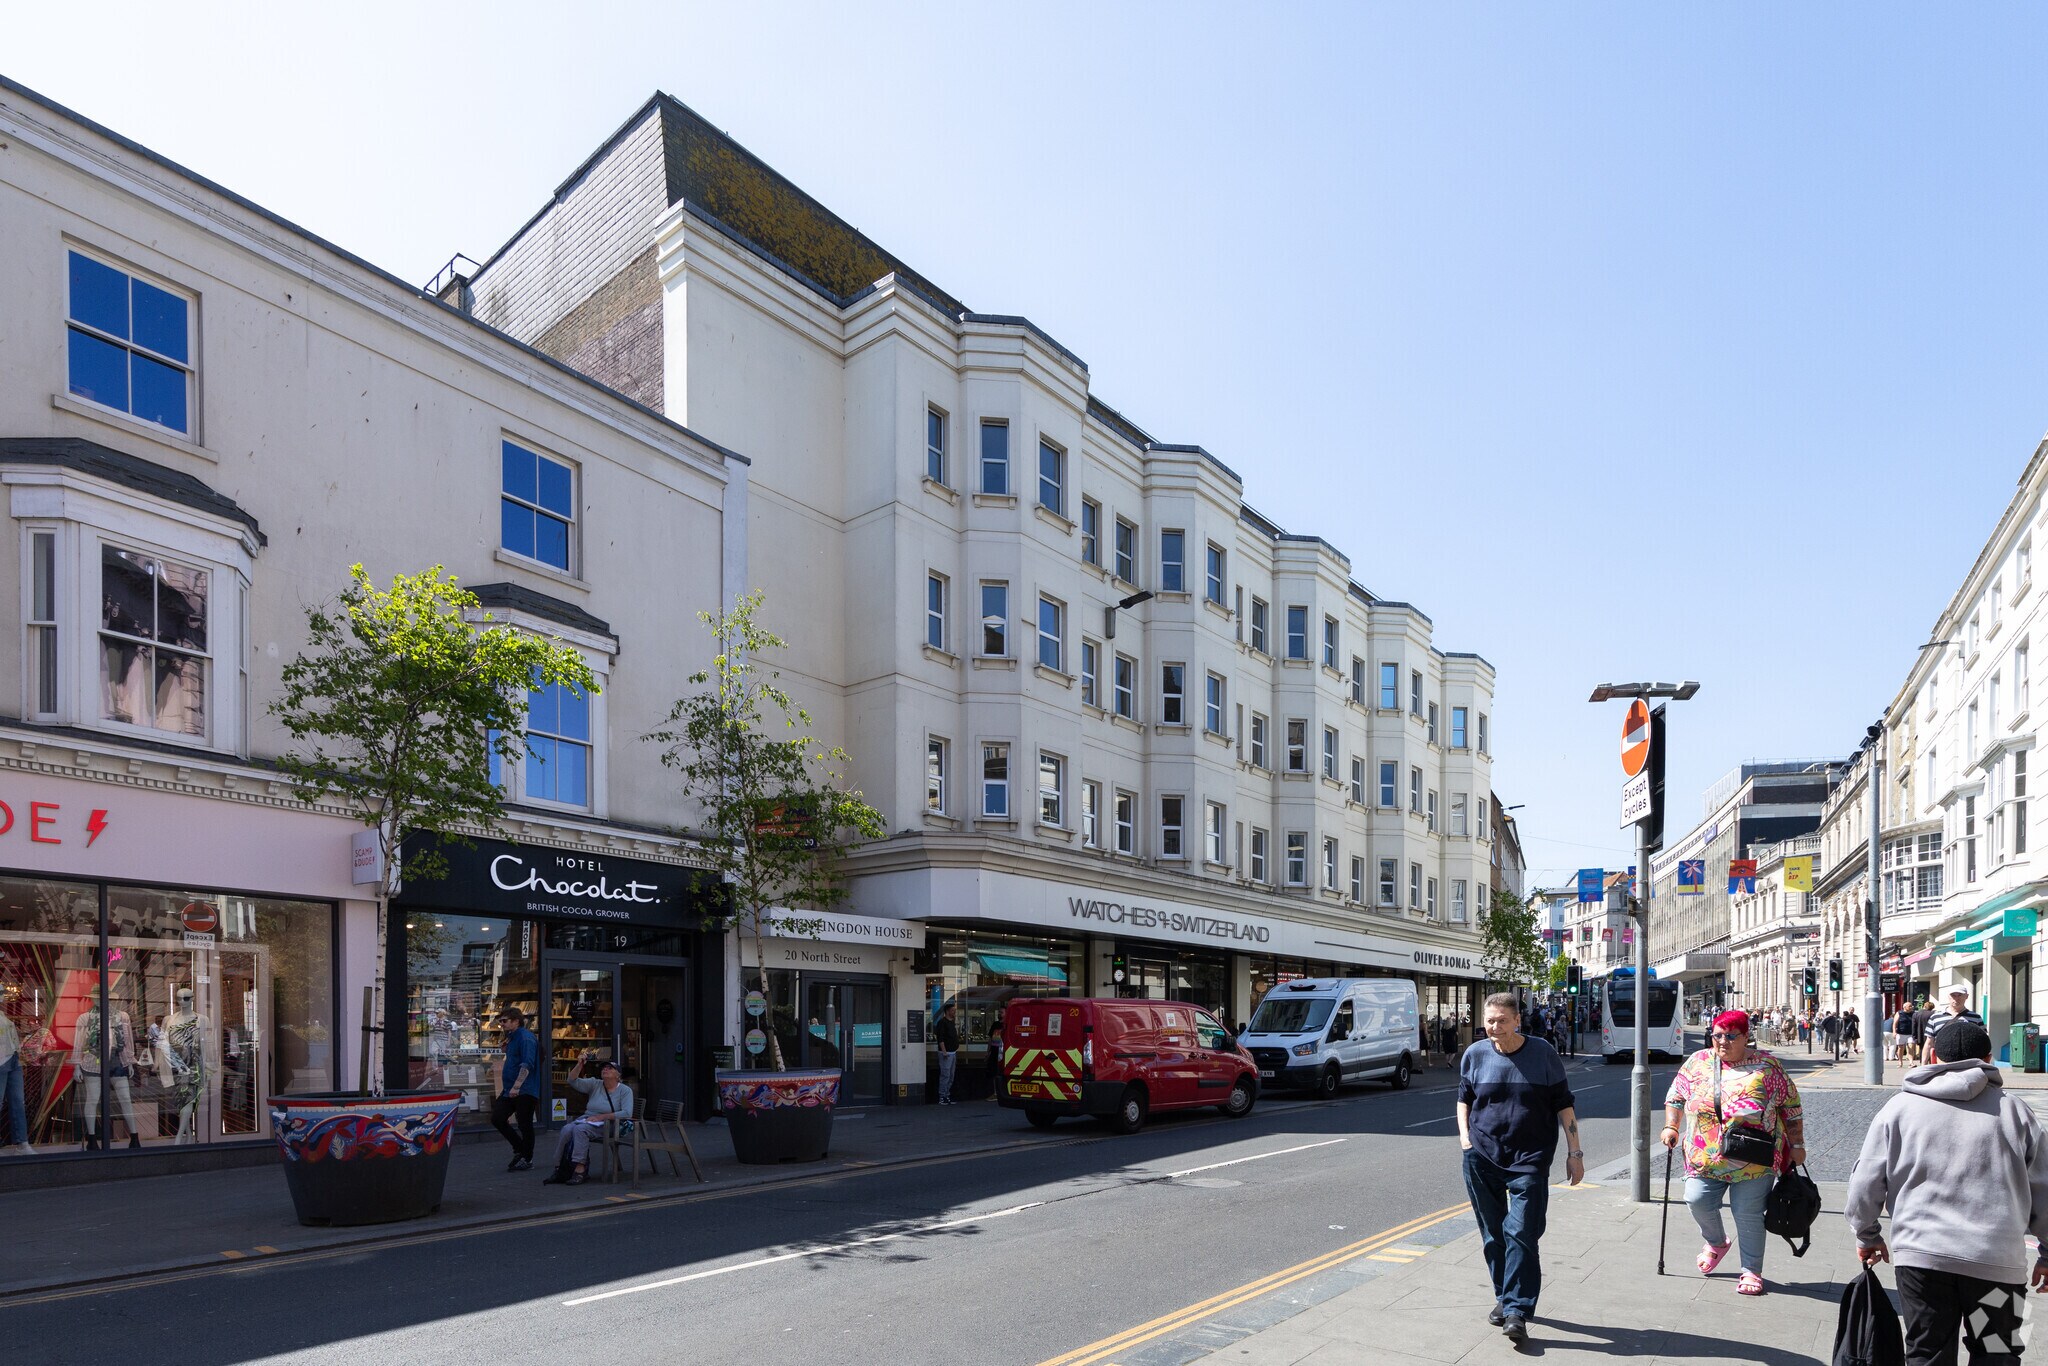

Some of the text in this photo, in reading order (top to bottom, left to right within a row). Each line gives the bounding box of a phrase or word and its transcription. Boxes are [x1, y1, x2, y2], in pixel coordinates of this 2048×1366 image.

[1624, 778, 1647, 802] Except
[1624, 798, 1647, 818] cycles
[355, 847, 373, 858] SCAMP
[556, 856, 605, 873] HOTEL
[527, 902, 630, 919] BRITISH COCOA GROWER
[1068, 896, 1157, 928] WATCHES
[1170, 913, 1270, 943] SWITZERLAND
[614, 935, 628, 947] 19
[875, 926, 913, 940] HOUSE
[784, 949, 861, 965] 20 North Street
[1413, 951, 1471, 970] OLIVER BONAS
[1069, 1008, 1080, 1017] 20
